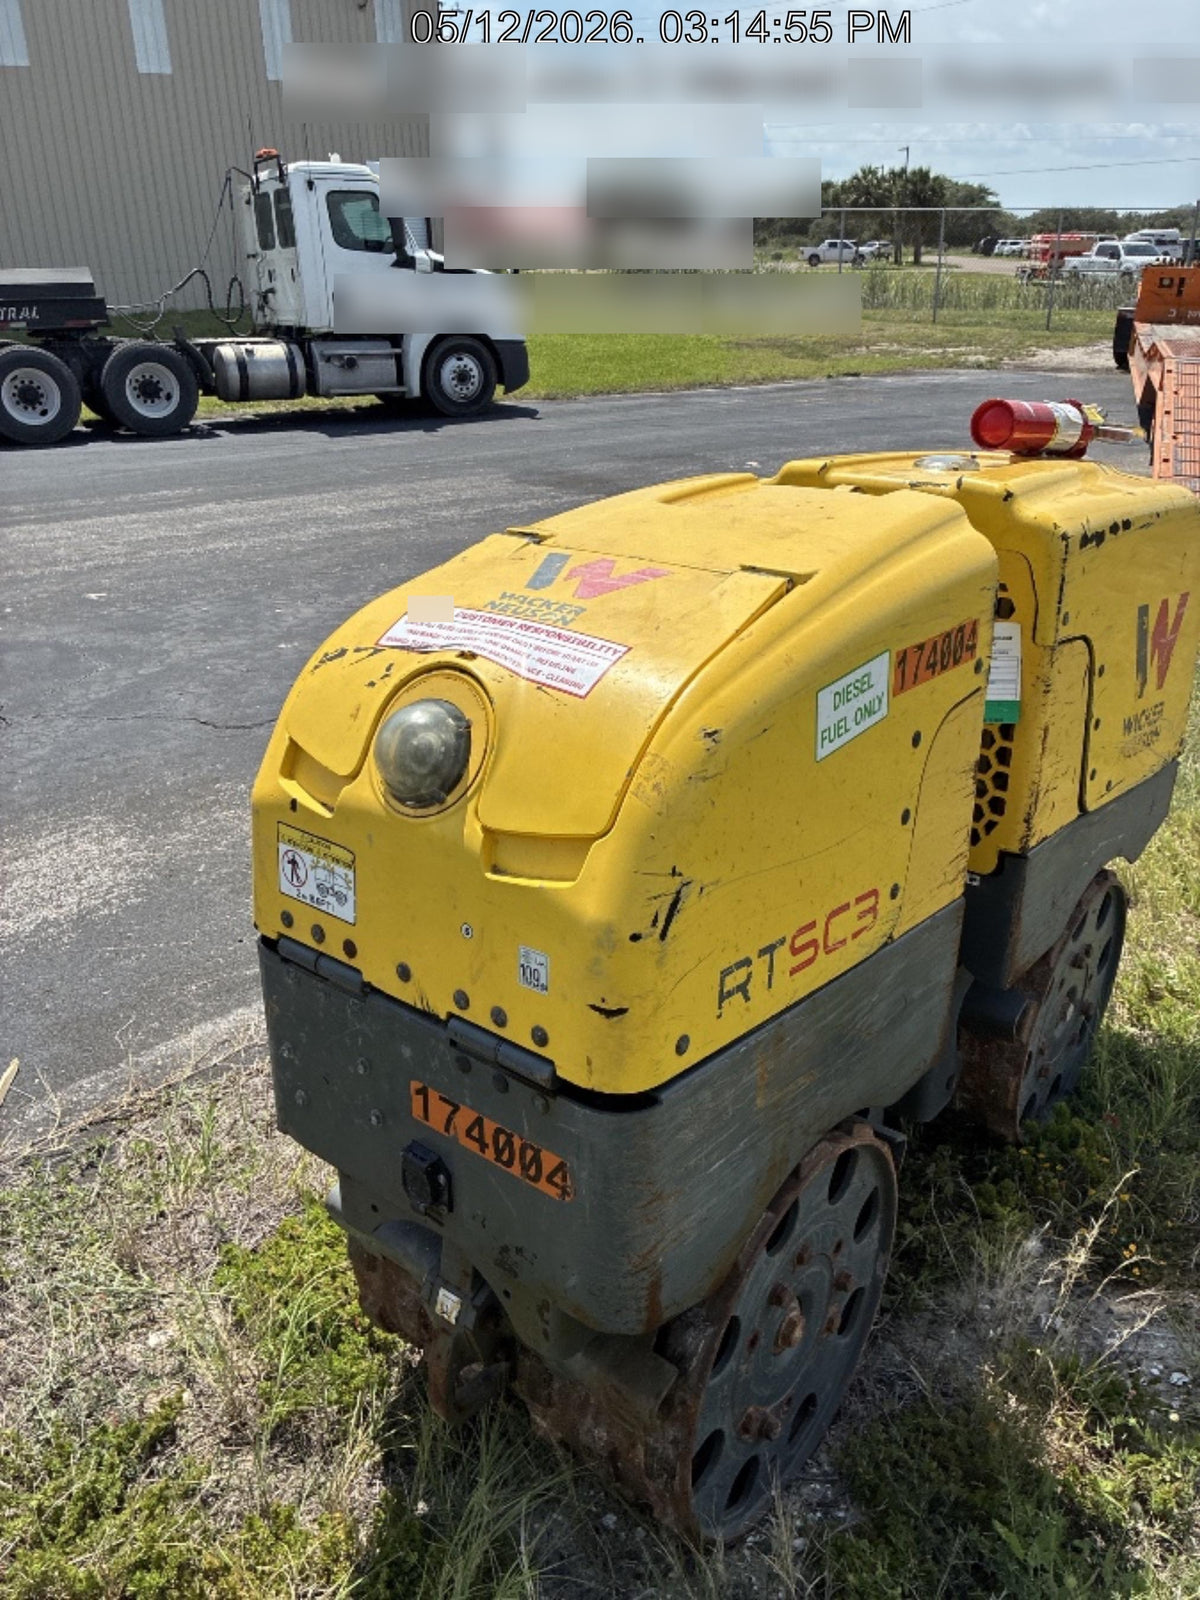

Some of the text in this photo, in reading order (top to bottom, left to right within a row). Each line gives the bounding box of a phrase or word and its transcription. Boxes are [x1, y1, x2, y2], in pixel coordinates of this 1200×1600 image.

[483, 601, 577, 626] NEUSON
[499, 591, 587, 616] WACKER
[517, 622, 622, 657] RESPONSIBILITY
[833, 671, 875, 711] DIESEL
[821, 691, 884, 749] FUEL ONLY
[414, 1085, 570, 1200] 174004
